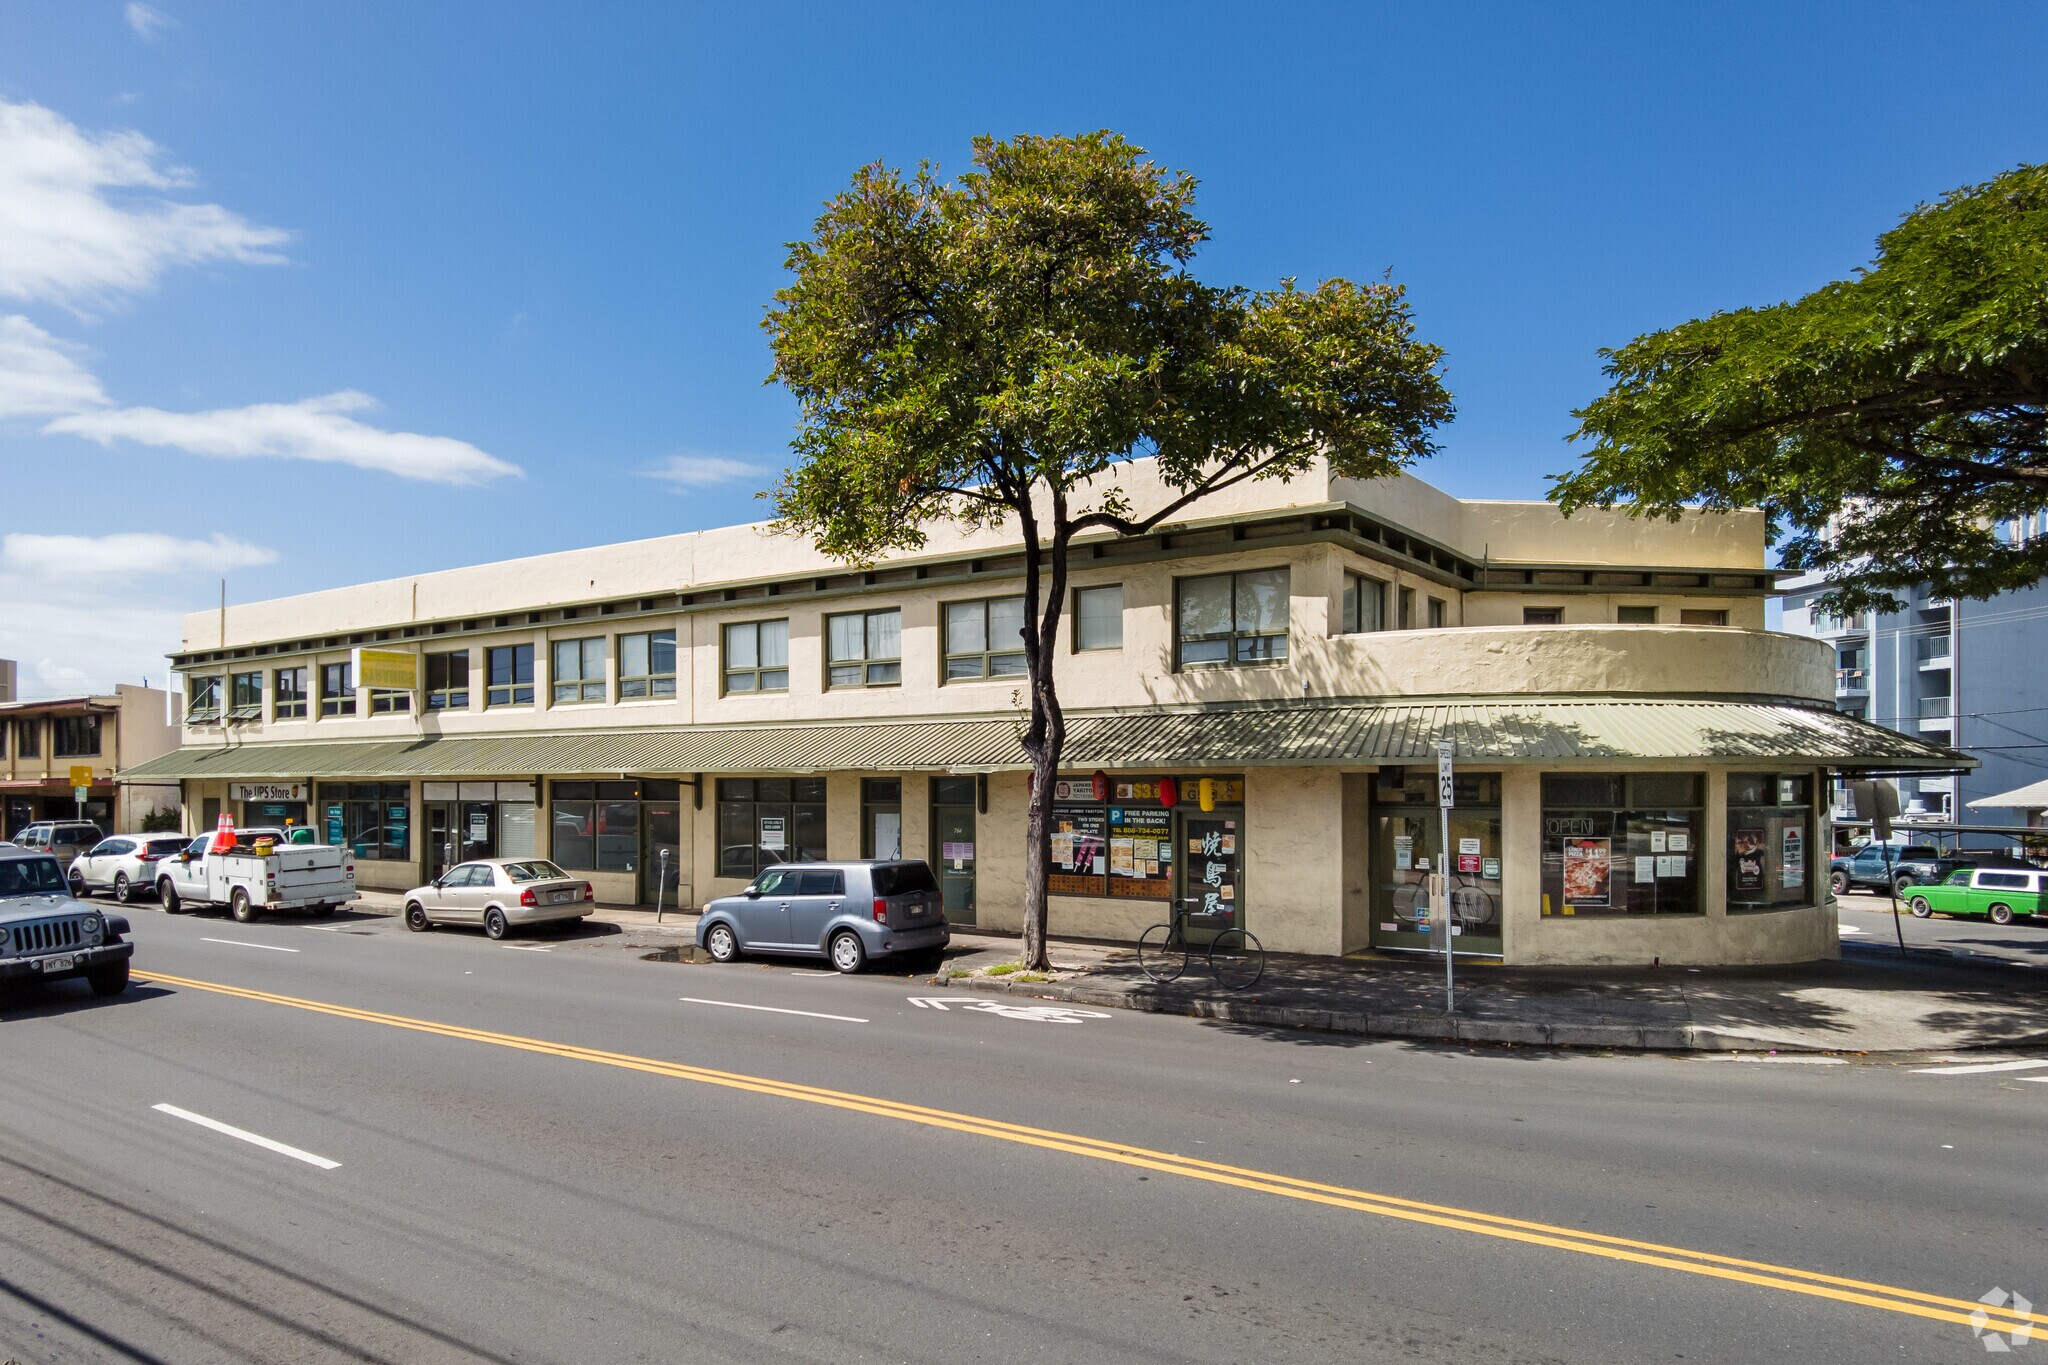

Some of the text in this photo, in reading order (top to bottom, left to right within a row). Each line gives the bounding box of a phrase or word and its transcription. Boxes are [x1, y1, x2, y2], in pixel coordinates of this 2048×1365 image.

[1440, 748, 1451, 759] SPEED
[1441, 762, 1451, 772] LIMIT
[240, 785, 290, 799] The UPS Store
[1441, 775, 1452, 801] 25
[1111, 810, 1120, 821] P
[1548, 820, 1591, 834] OPEN
[1202, 831, 1222, 913] 焼鳥屋
